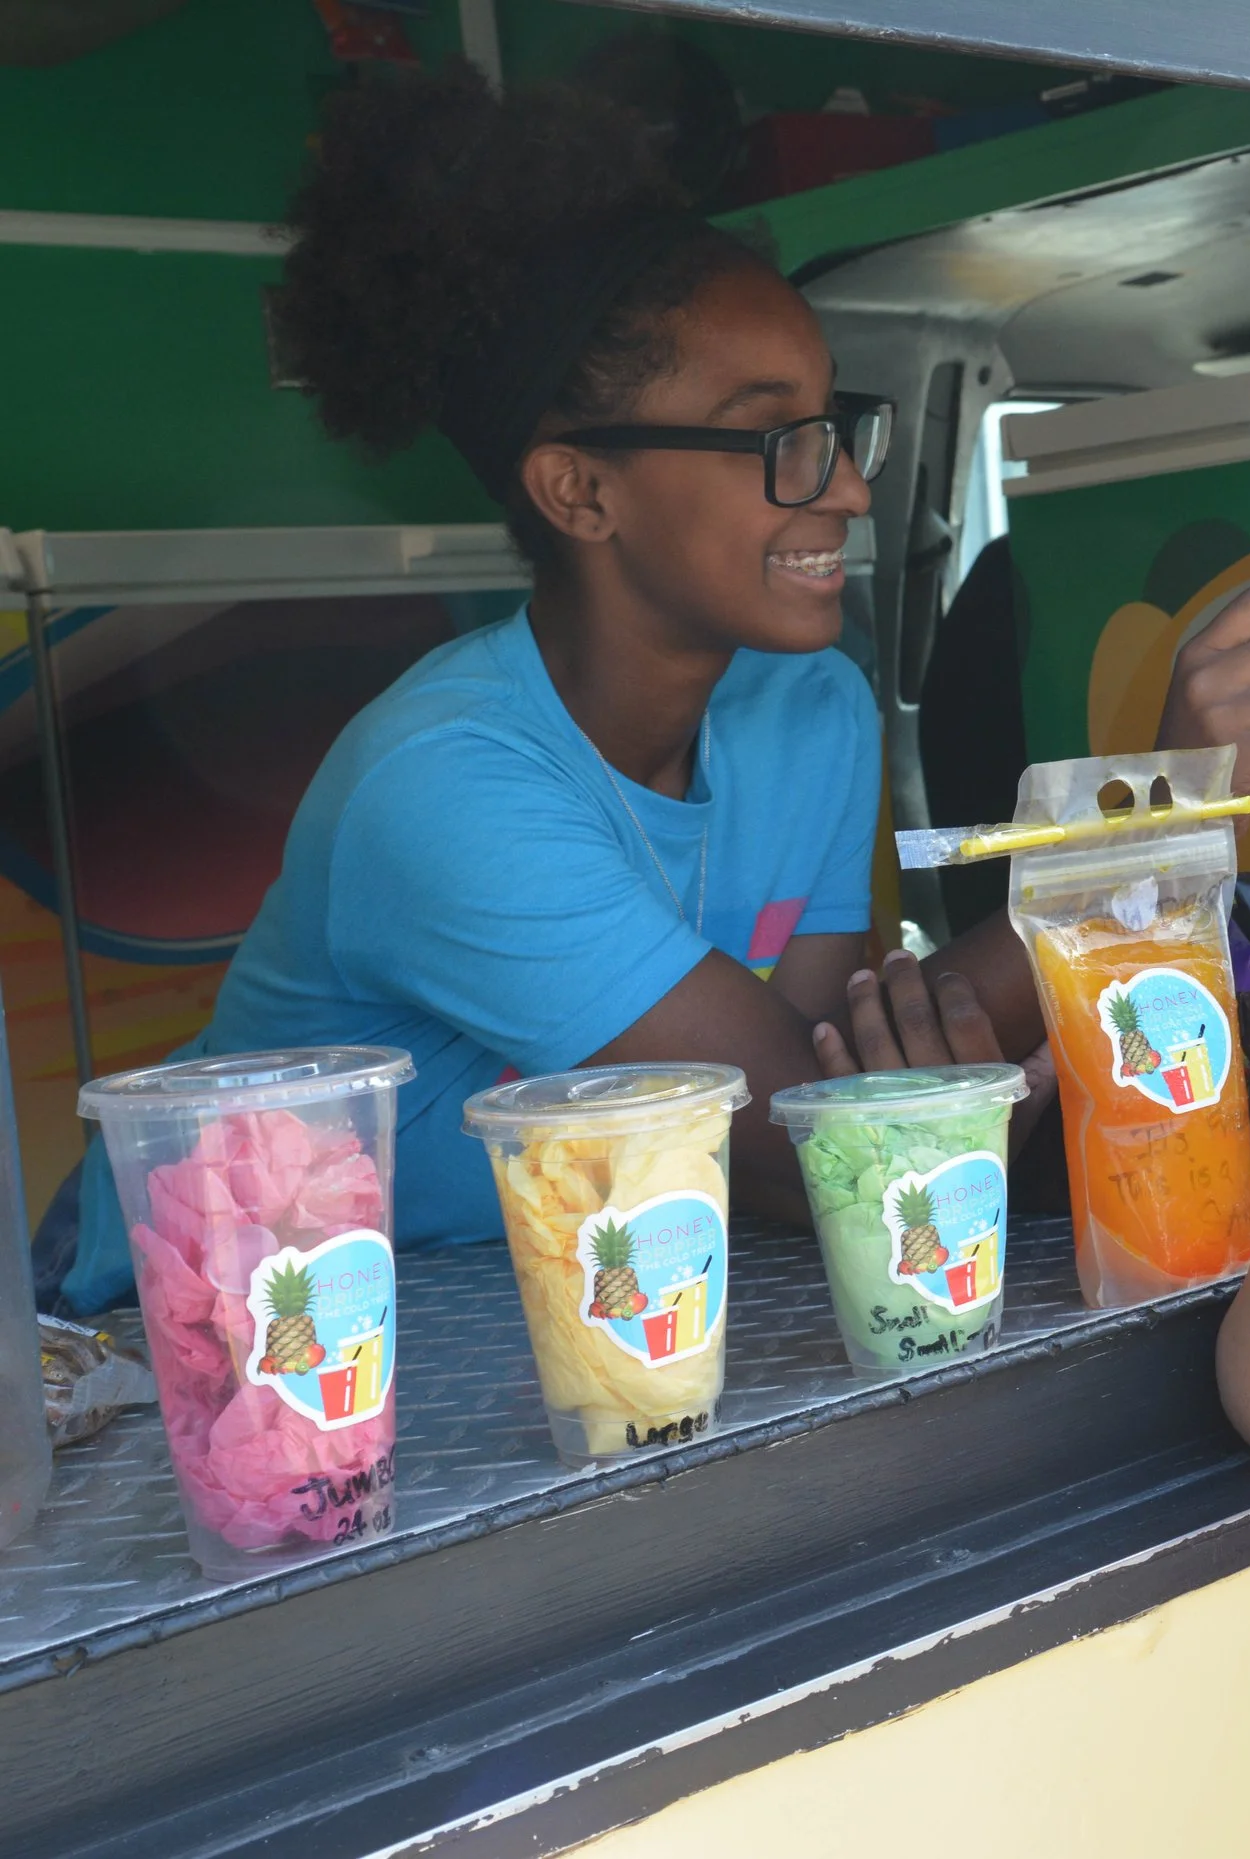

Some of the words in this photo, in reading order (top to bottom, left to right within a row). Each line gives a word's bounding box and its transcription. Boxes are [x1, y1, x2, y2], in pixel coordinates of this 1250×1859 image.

[1139, 988, 1198, 1014] HONEY
[936, 1169, 1000, 1209] HONEY
[636, 1211, 716, 1249] HONEY
[638, 1261, 661, 1272] THE
[662, 1252, 690, 1267] COLD
[333, 1508, 368, 1547] 24
